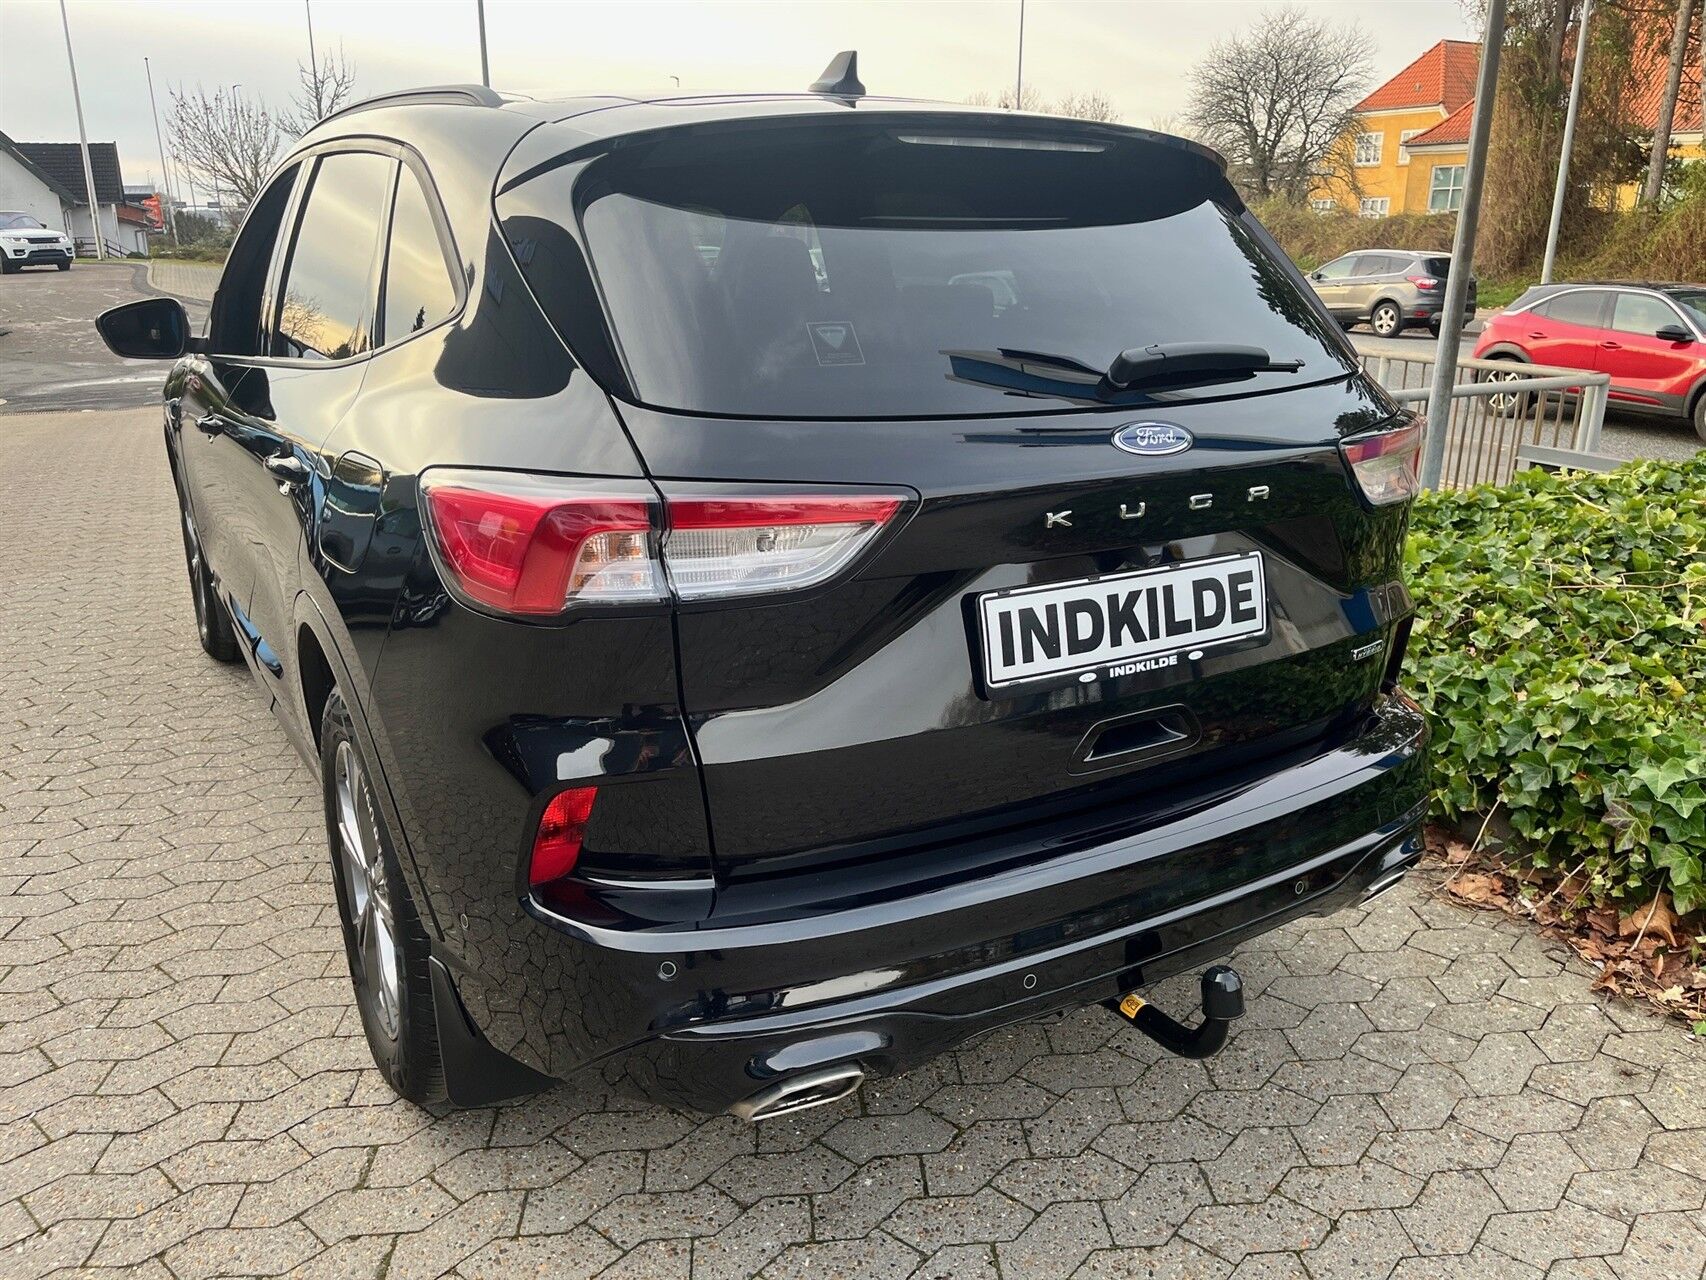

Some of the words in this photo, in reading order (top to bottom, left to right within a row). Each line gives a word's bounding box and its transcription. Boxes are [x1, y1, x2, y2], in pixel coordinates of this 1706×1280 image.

[1136, 426, 1177, 446] Ford
[1045, 484, 1271, 529] KUGA
[998, 569, 1257, 667] INDKILDE
[1108, 655, 1178, 678] INDKILDE
